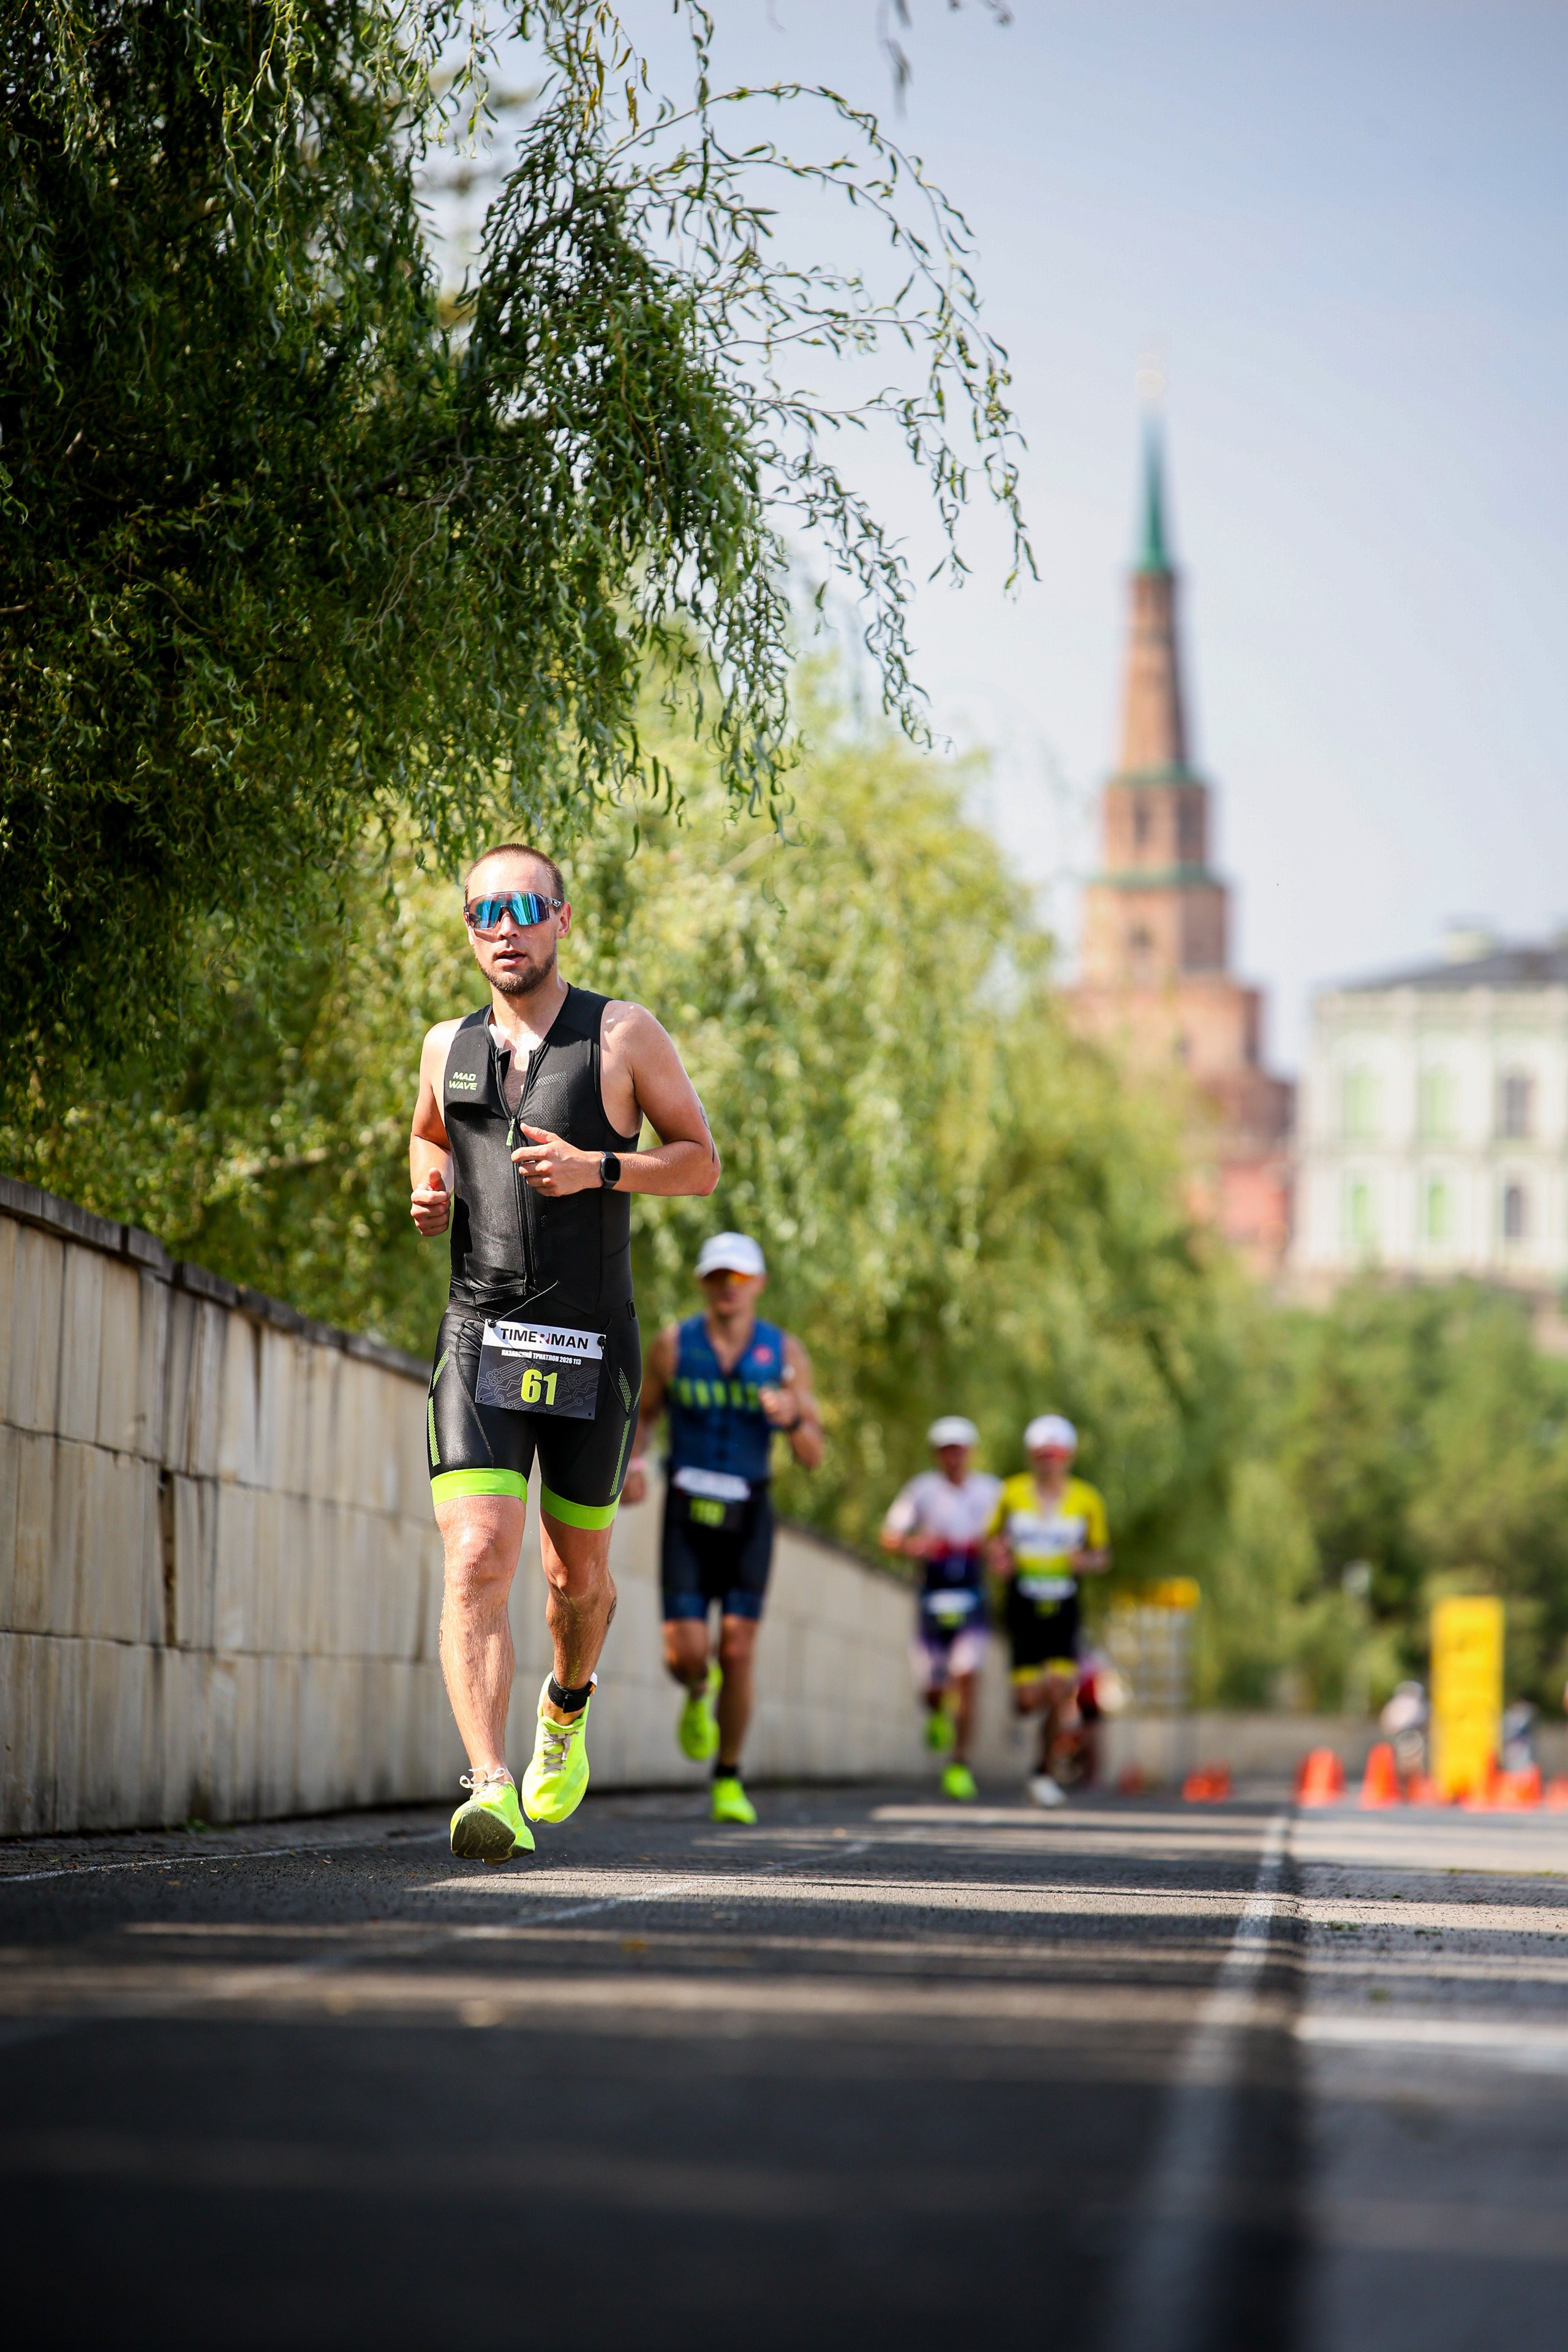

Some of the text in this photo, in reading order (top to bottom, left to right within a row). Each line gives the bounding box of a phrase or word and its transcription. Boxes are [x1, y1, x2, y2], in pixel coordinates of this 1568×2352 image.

[453, 1071, 477, 1081] MAD
[449, 1080, 478, 1090] WAVE
[533, 1352, 559, 1362] ТРИАТЛОН
[559, 1356, 573, 1365] 2026
[521, 1368, 558, 1405] 61
